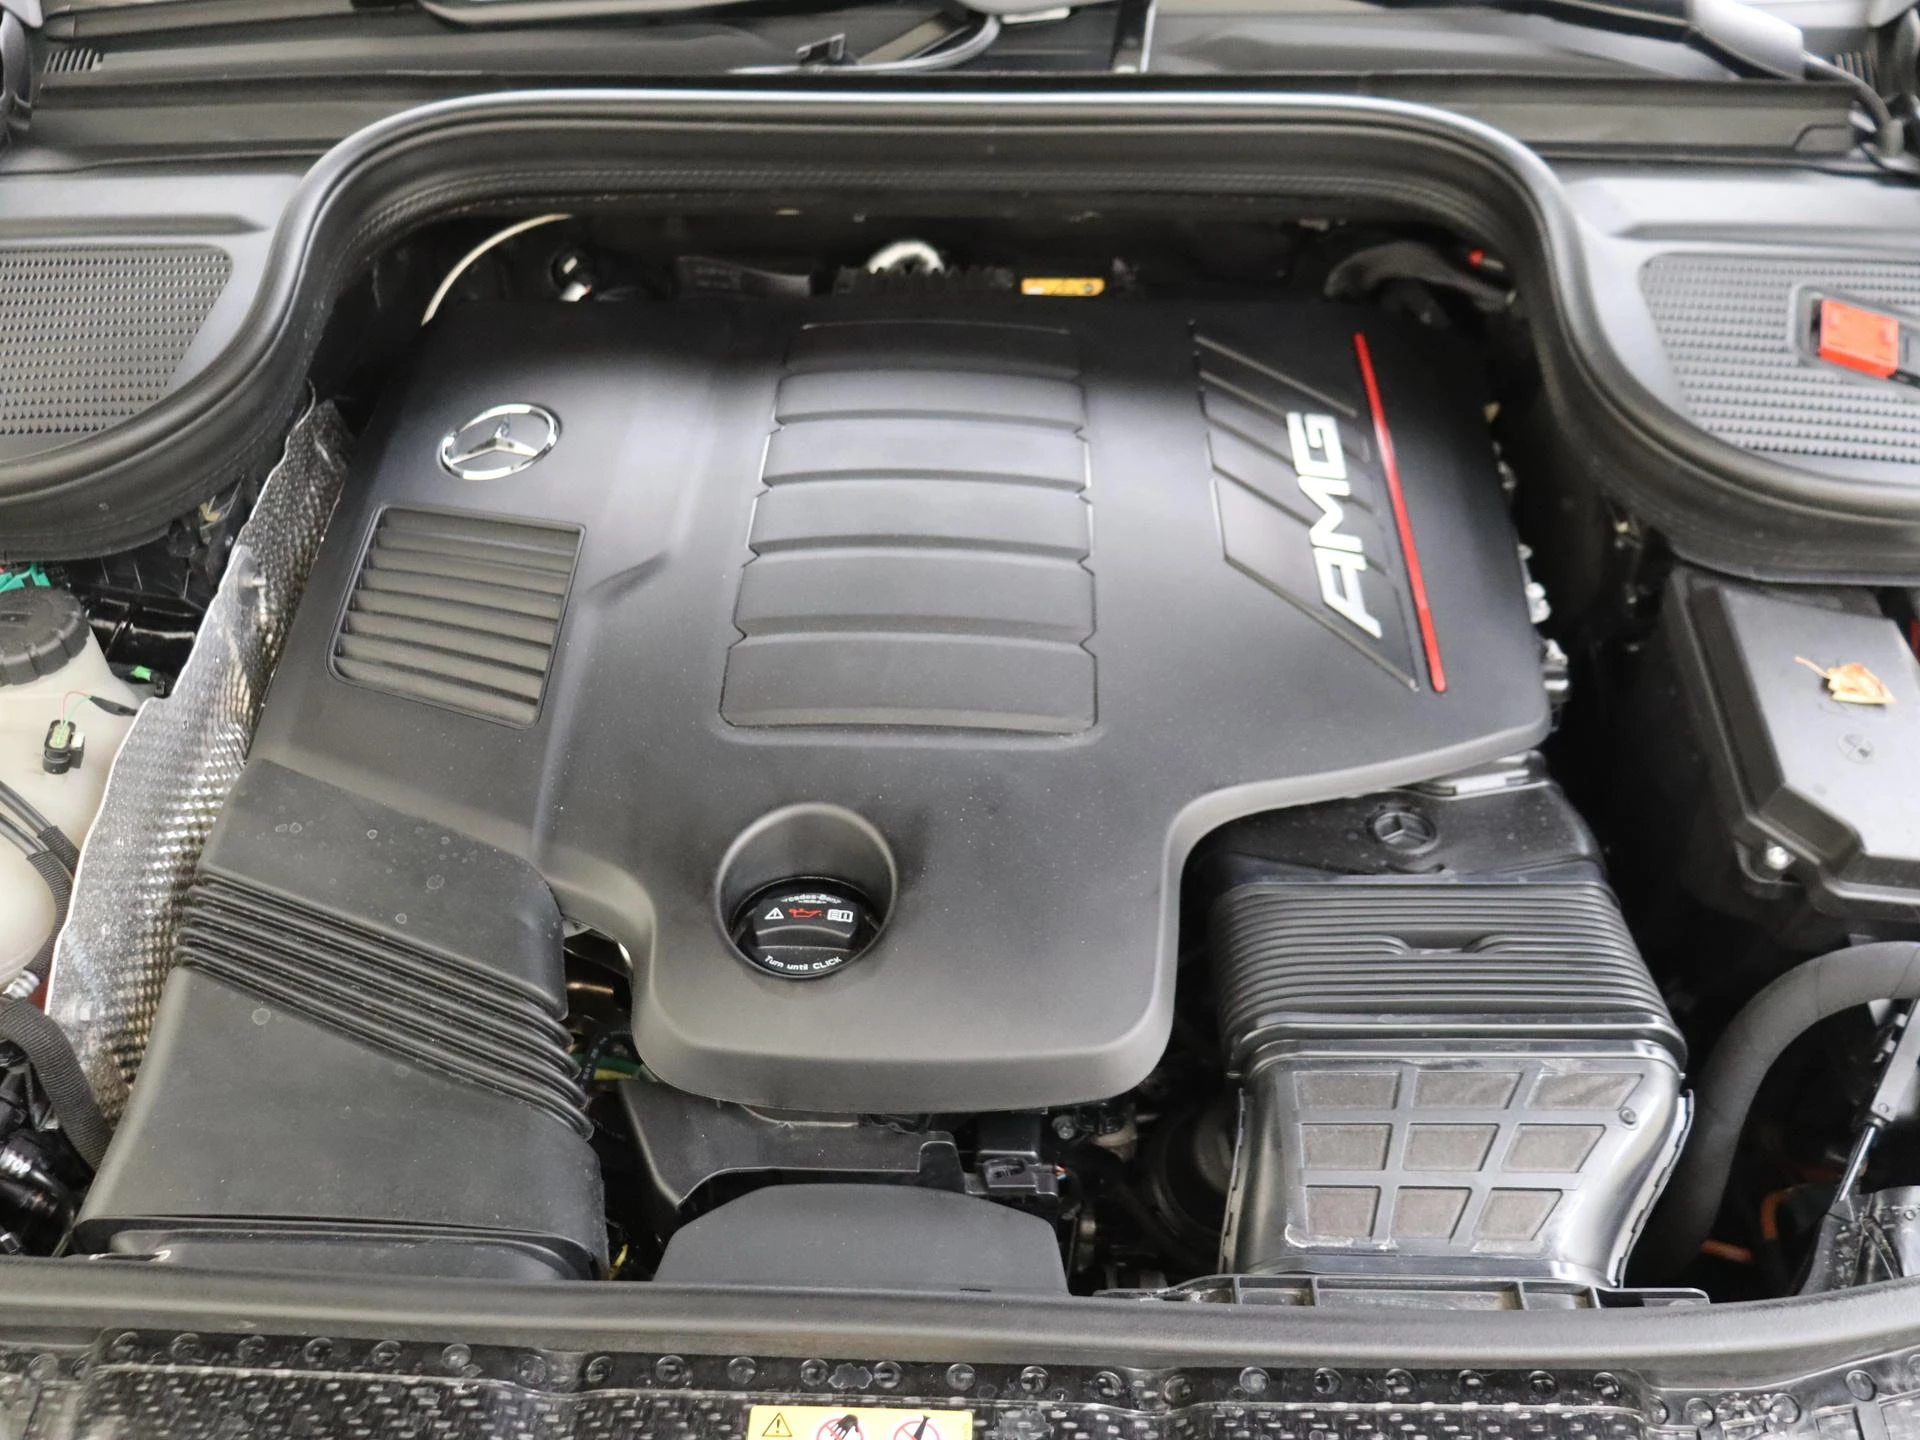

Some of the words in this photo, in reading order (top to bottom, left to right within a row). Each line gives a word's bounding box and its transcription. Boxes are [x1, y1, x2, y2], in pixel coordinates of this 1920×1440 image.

[1286, 411, 1383, 639] AMG
[765, 955, 784, 968] Turn
[787, 963, 808, 971] until
[812, 956, 842, 970] CLICK
